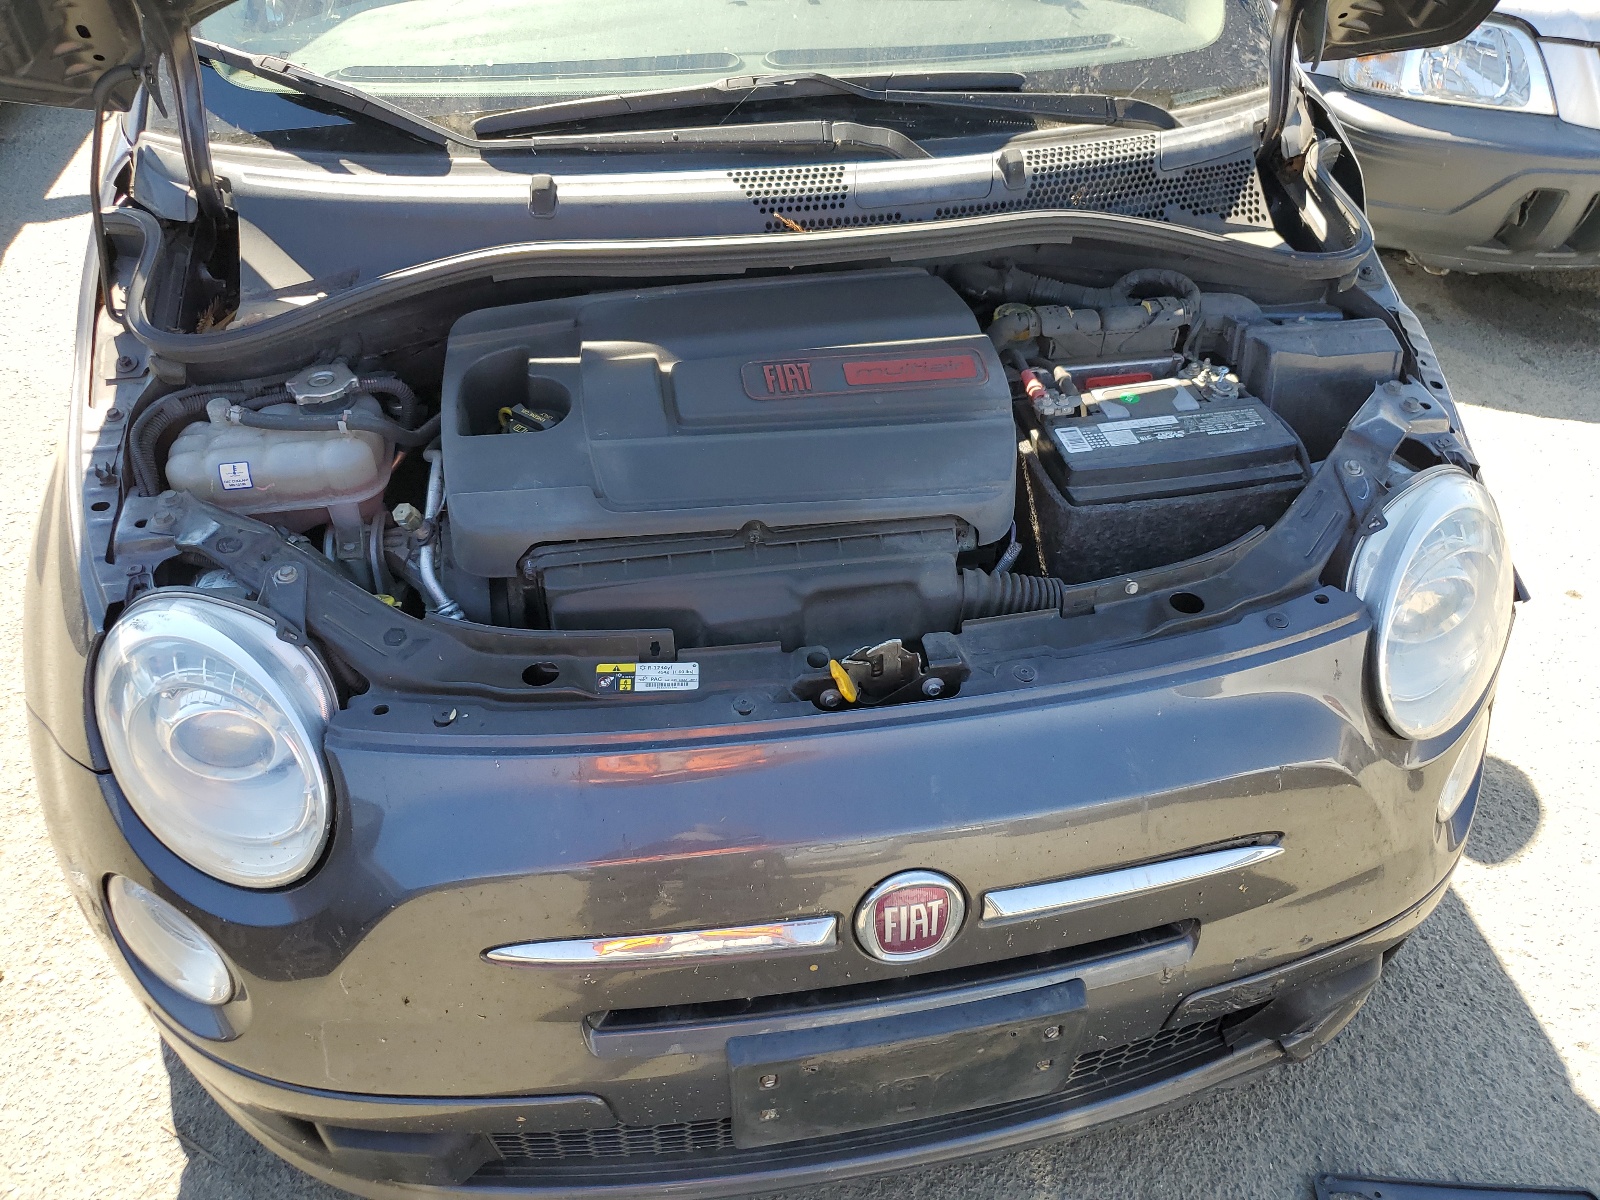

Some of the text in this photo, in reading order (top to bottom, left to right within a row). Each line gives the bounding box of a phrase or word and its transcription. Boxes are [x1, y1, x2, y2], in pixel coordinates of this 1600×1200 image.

[763, 362, 812, 392] FIAT
[856, 360, 964, 376] multiair
[884, 898, 944, 943] FIAT
